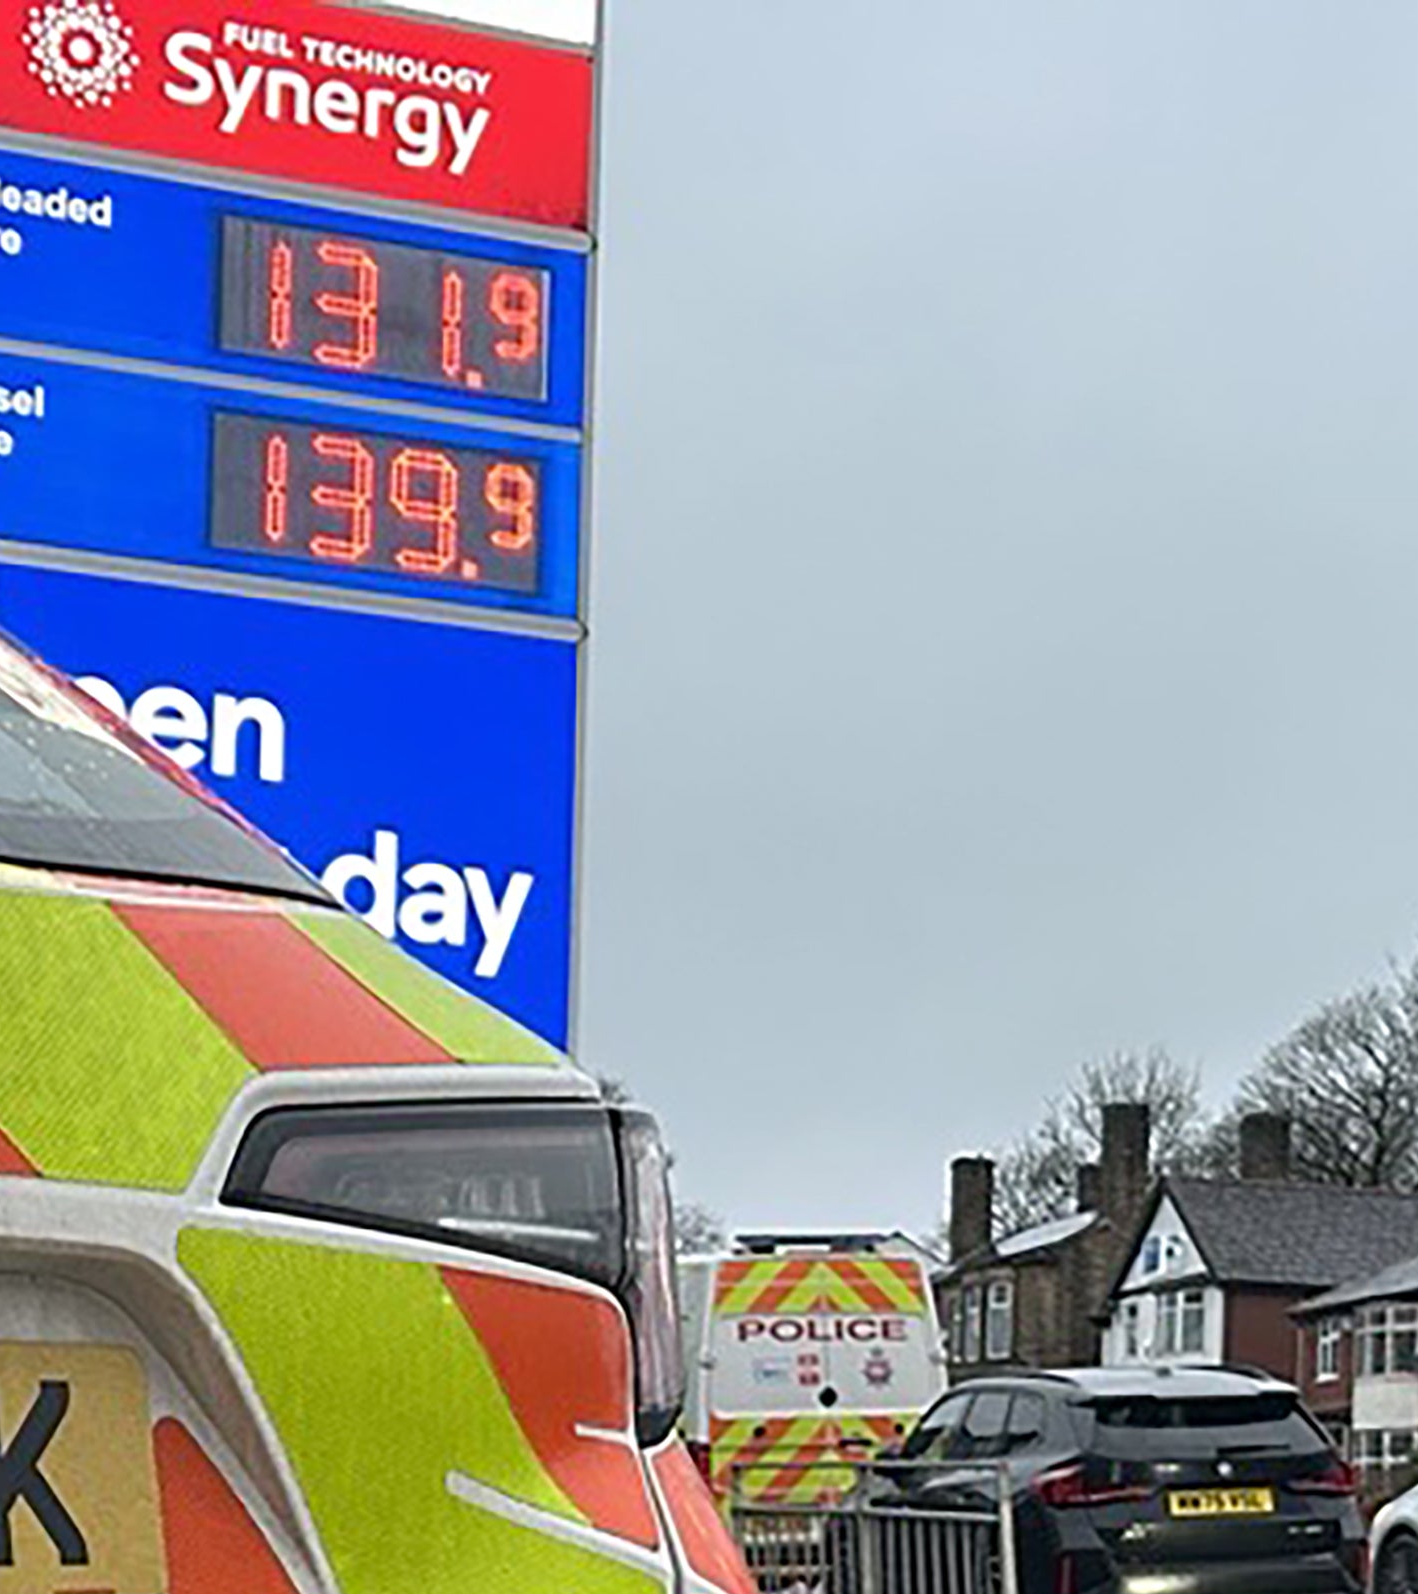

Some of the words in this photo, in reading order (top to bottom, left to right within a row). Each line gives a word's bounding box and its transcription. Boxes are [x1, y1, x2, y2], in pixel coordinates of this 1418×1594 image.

[163, 31, 491, 175] Synergy
[223, 22, 294, 58] FUEL
[301, 36, 491, 95] TECHNOLOGY
[268, 238, 539, 389] 131.9
[263, 433, 535, 580] 139.9
[320, 829, 535, 978] day
[737, 1318, 908, 1342] POLICE
